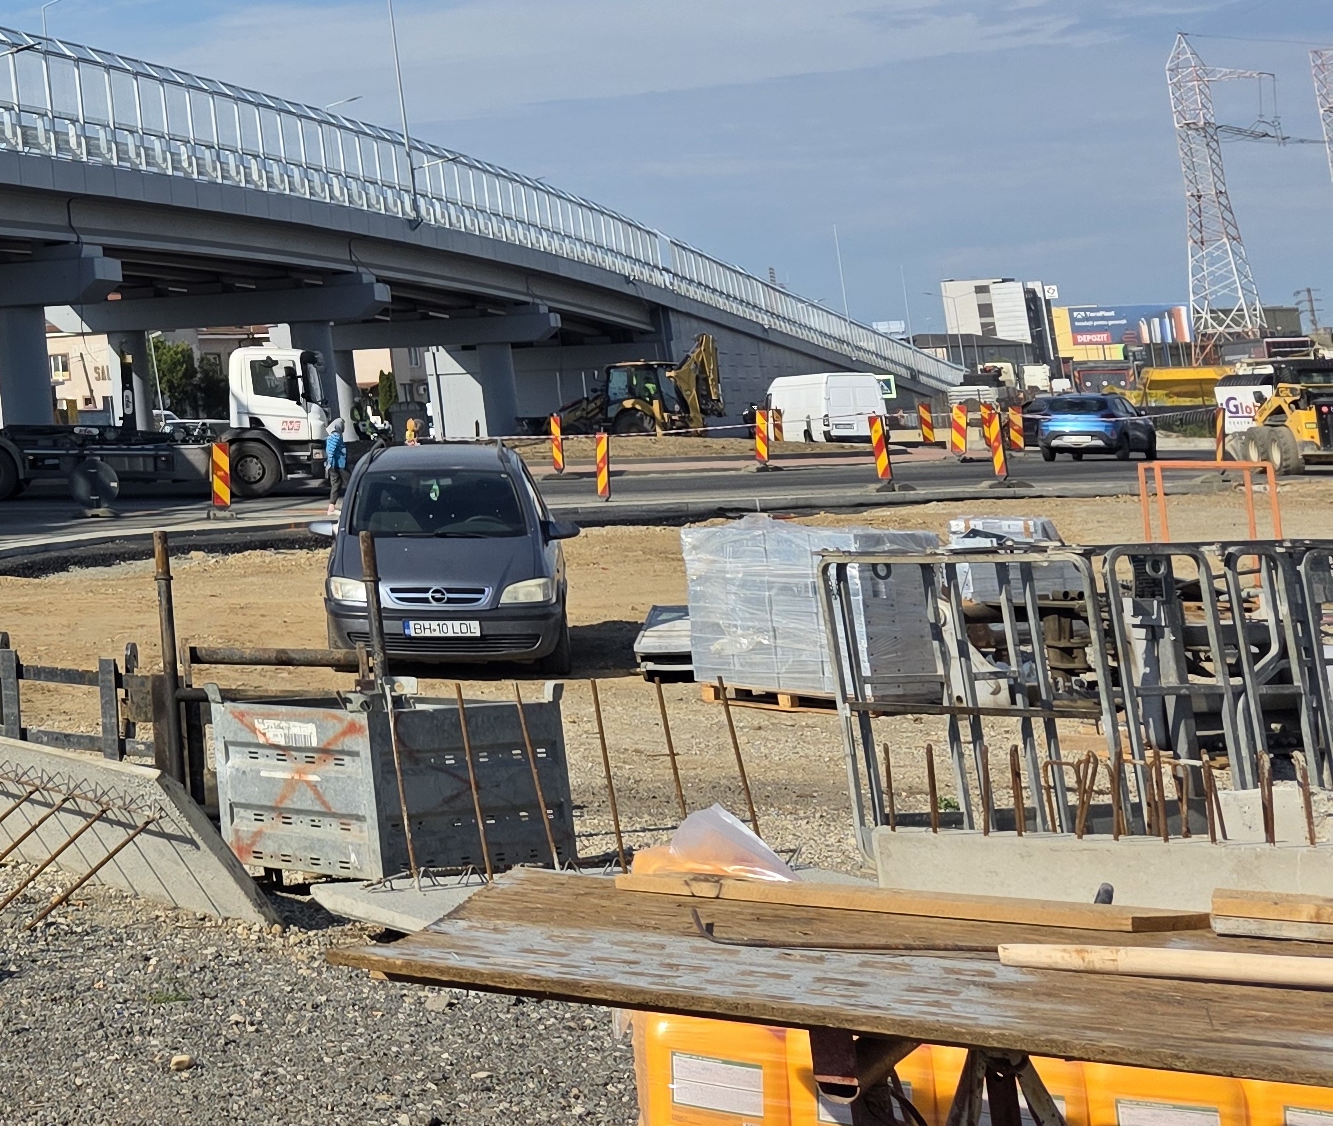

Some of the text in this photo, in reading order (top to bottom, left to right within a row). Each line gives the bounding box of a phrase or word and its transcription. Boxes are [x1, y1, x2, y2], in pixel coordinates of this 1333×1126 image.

[1077, 334, 1108, 342] DEPOZIT
[1225, 396, 1260, 415] Glob
[437, 623, 449, 634] 10
[452, 623, 476, 634] LDL
